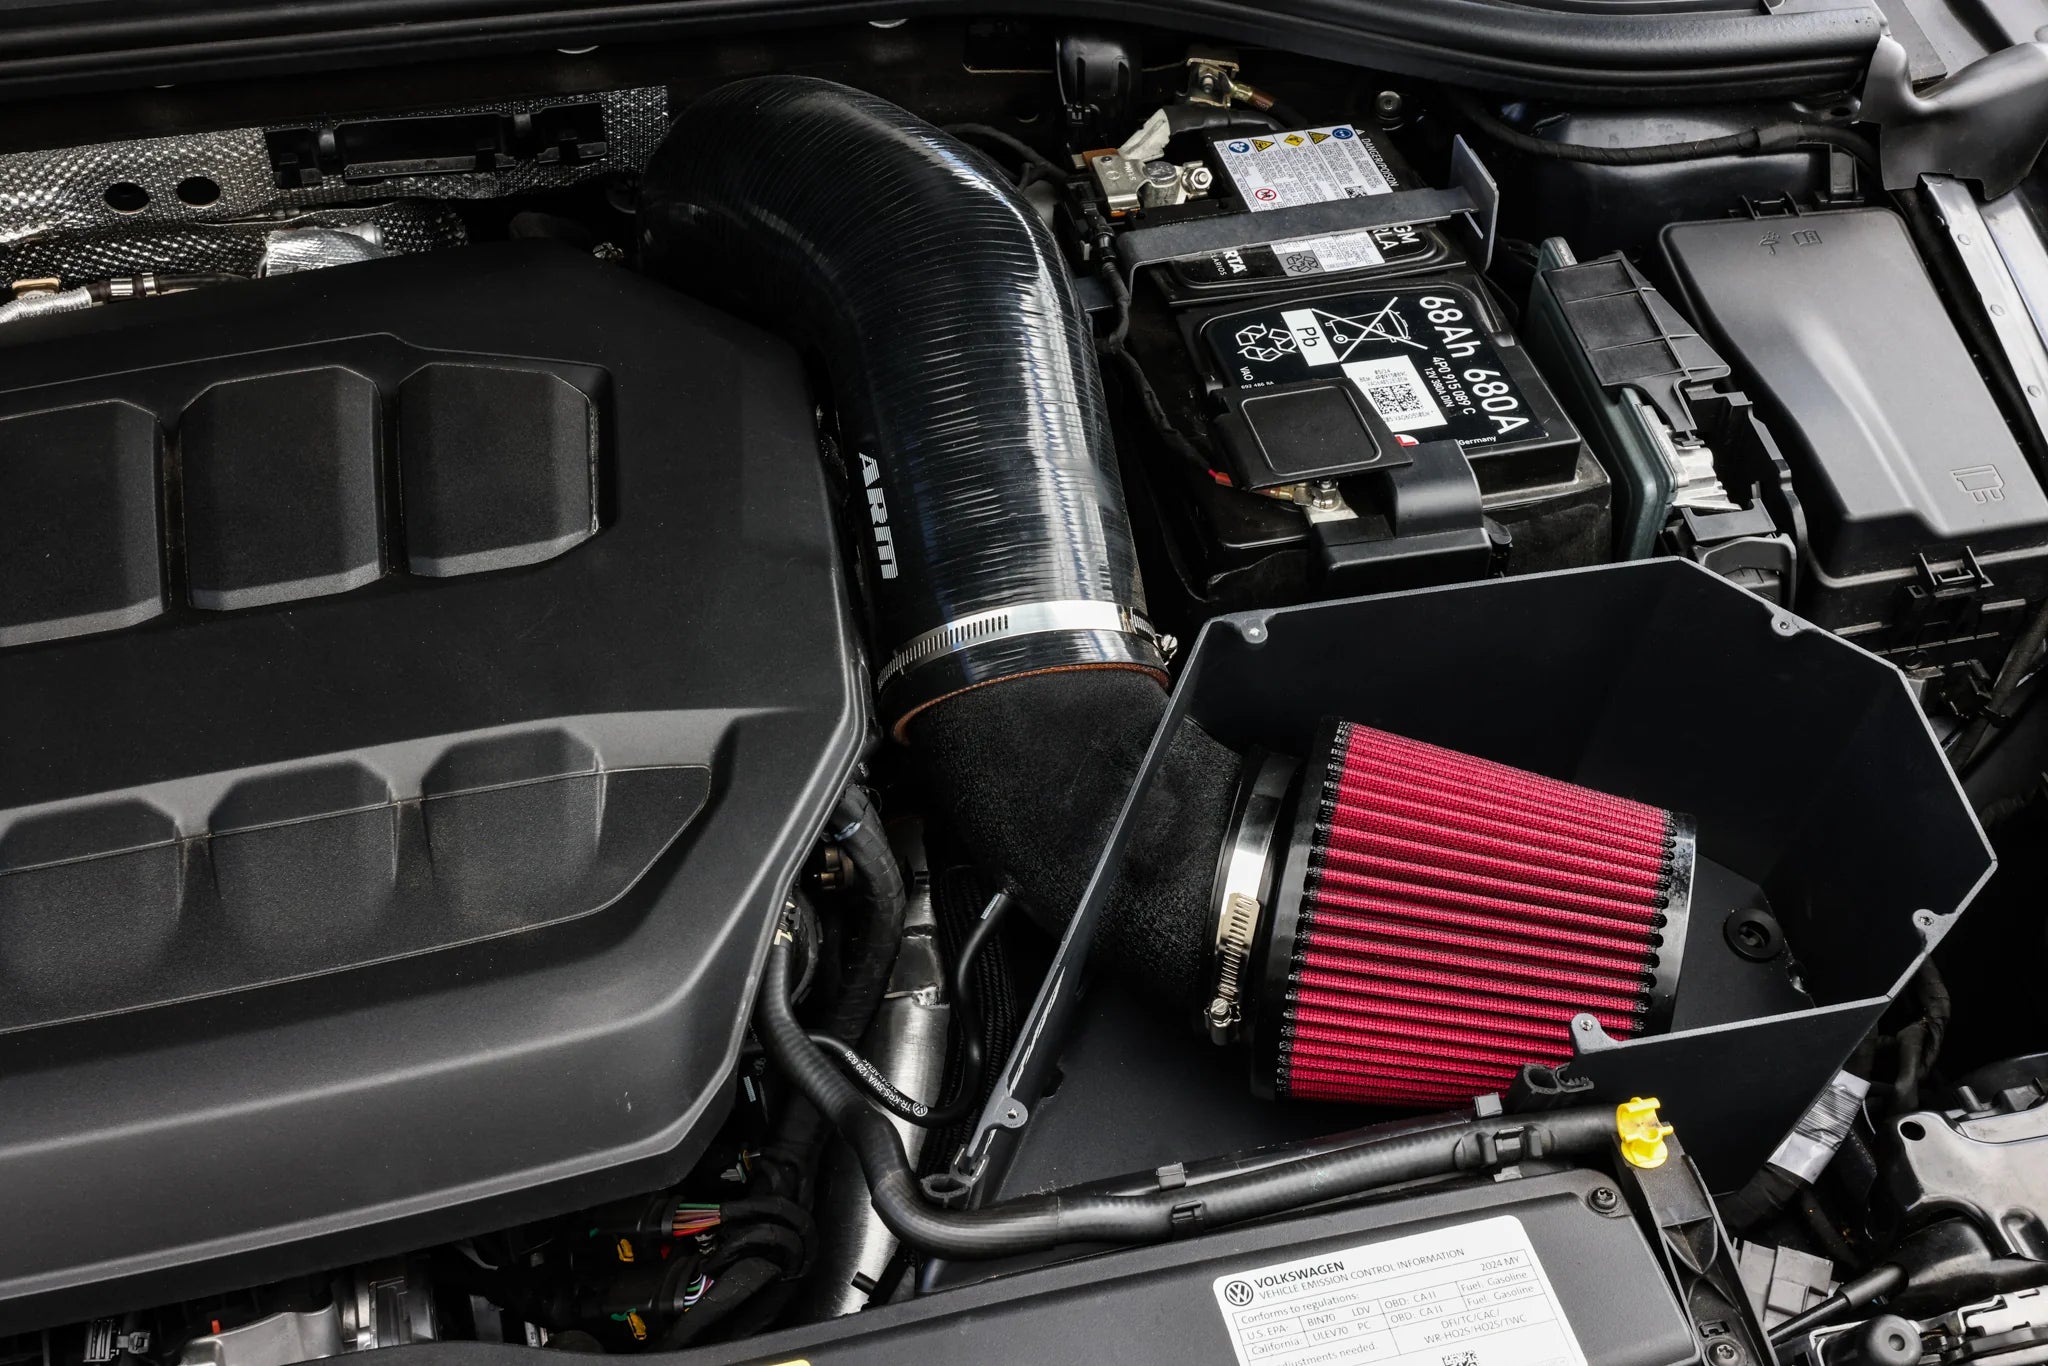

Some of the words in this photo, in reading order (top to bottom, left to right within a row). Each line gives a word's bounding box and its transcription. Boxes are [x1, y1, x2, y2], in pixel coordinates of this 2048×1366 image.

[1361, 138, 1399, 187] DANGER/POISON
[1372, 227, 1399, 251] RLA
[1393, 225, 1420, 244] GM
[1223, 250, 1247, 274] RTA
[1296, 327, 1320, 347] Pb
[1419, 296, 1481, 358] 68Ah
[1463, 368, 1530, 434] 680A
[1424, 367, 1438, 380] 12V
[1440, 394, 1455, 408] DIN
[1445, 374, 1462, 390] 915
[1452, 389, 1471, 406] 089
[1462, 407, 1476, 415] C
[1458, 435, 1497, 446] Germany
[856, 1063, 869, 1077] 129
[1480, 1259, 1503, 1272] 2024
[1504, 1255, 1520, 1266] MY
[1254, 1261, 1345, 1289] VOLKSWAGEN
[1259, 1284, 1299, 1301] VEHICLE
[1301, 1274, 1349, 1291] EMISSION
[1350, 1264, 1395, 1279] CONTROL
[1397, 1248, 1465, 1269] INFORMATION
[1487, 1271, 1527, 1287] Gasoline
[1384, 1297, 1410, 1309] OBD:
[1413, 1293, 1428, 1303] CA
[1493, 1285, 1534, 1300] Gasoline
[1241, 1308, 1289, 1325] Conforms
[1290, 1305, 1301, 1315] to
[1303, 1292, 1360, 1311] regulations:
[1351, 1305, 1371, 1317] LDV
[1390, 1311, 1415, 1324] OBD:
[1419, 1307, 1434, 1317] CA
[1307, 1313, 1336, 1327] BIN70
[1357, 1321, 1371, 1331] PC
[1312, 1327, 1349, 1342] ULEV70
[1251, 1337, 1303, 1356] California:
